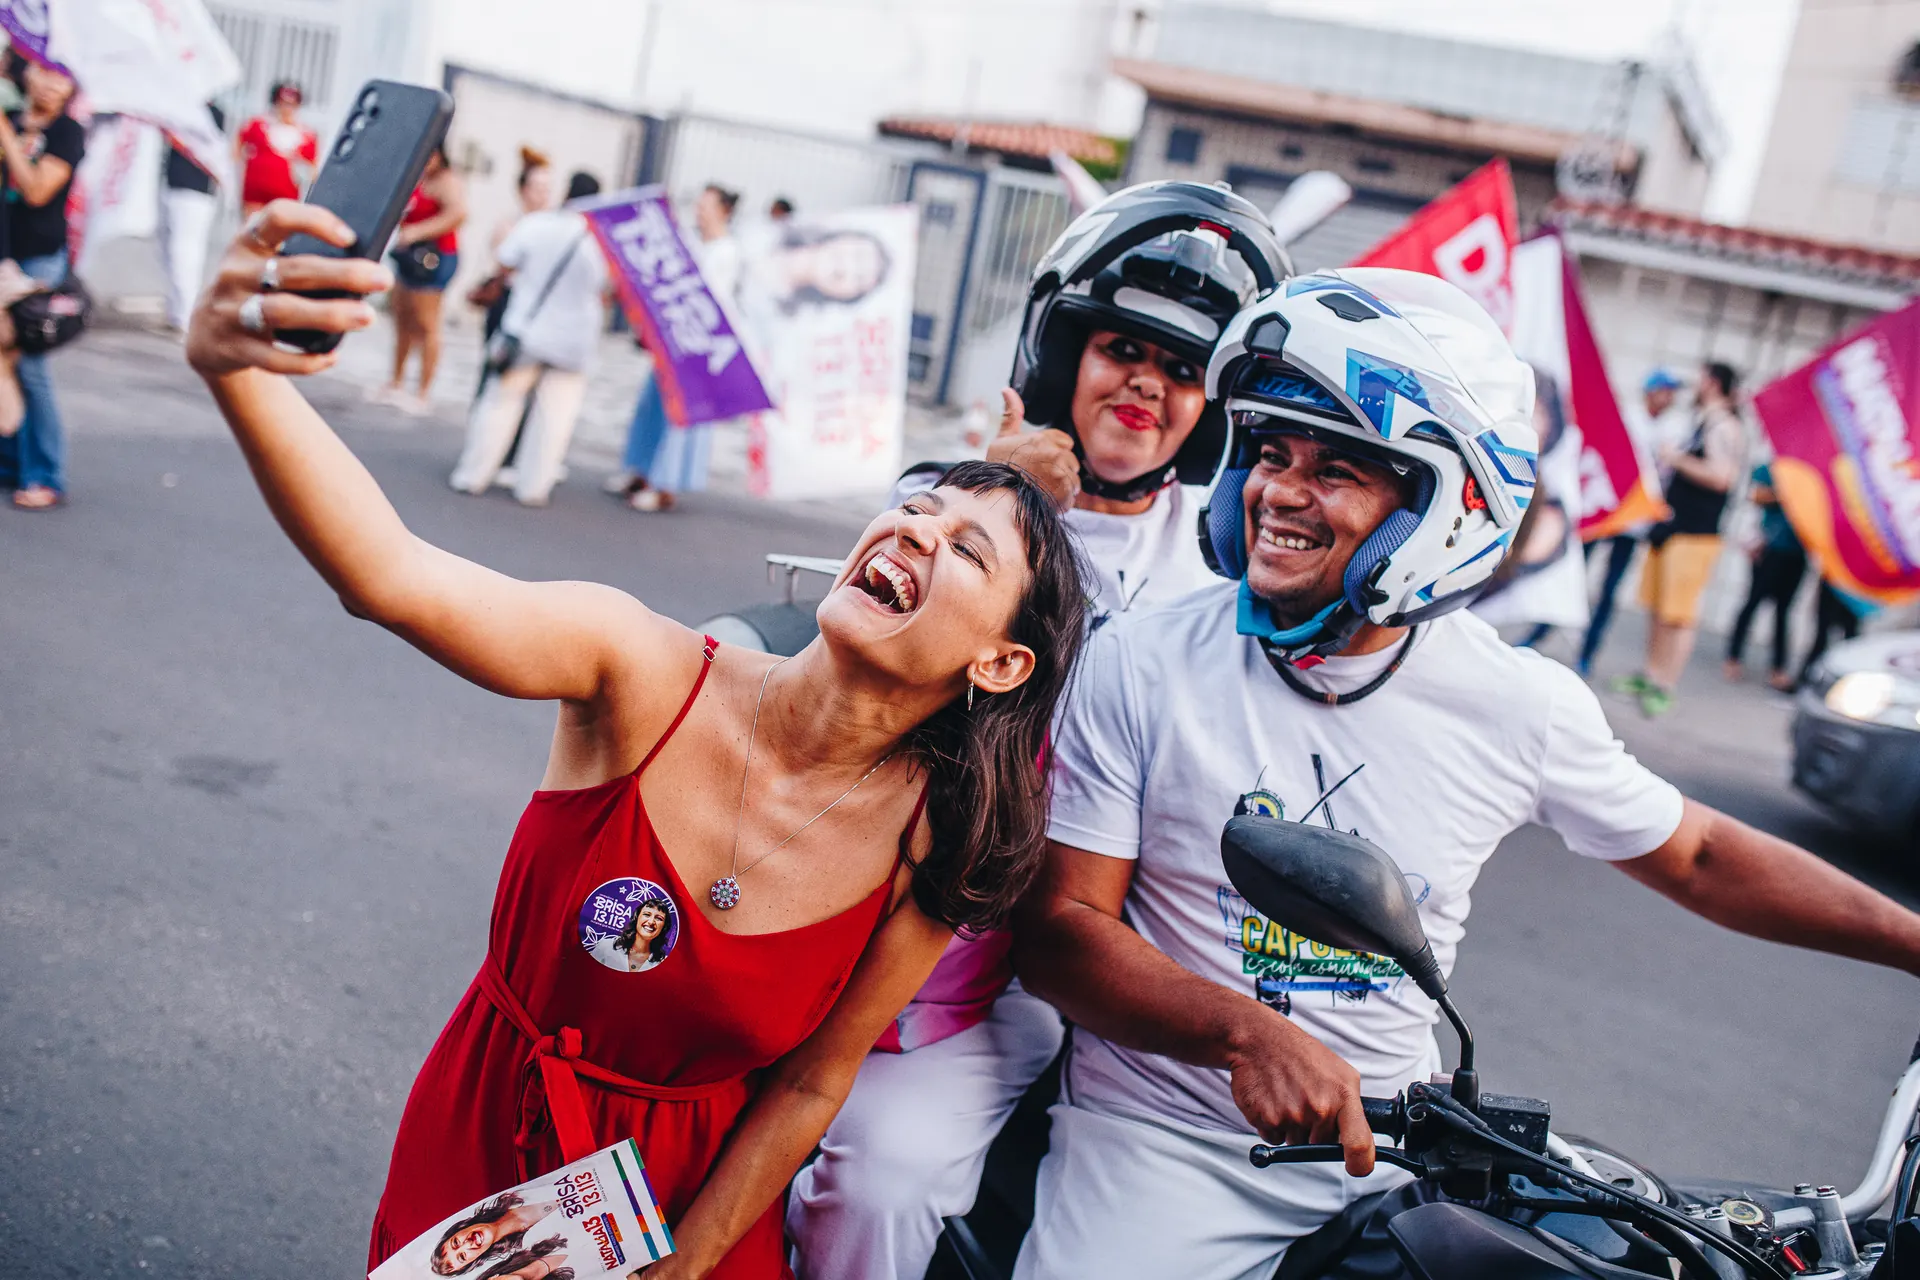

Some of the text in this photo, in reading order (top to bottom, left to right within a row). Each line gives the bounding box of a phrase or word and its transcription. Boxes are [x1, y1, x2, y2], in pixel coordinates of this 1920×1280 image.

[593, 896, 632, 919] BRISA
[593, 908, 626, 929] 13.113
[554, 1173, 584, 1219] BRISA
[574, 1171, 602, 1208] 13.113
